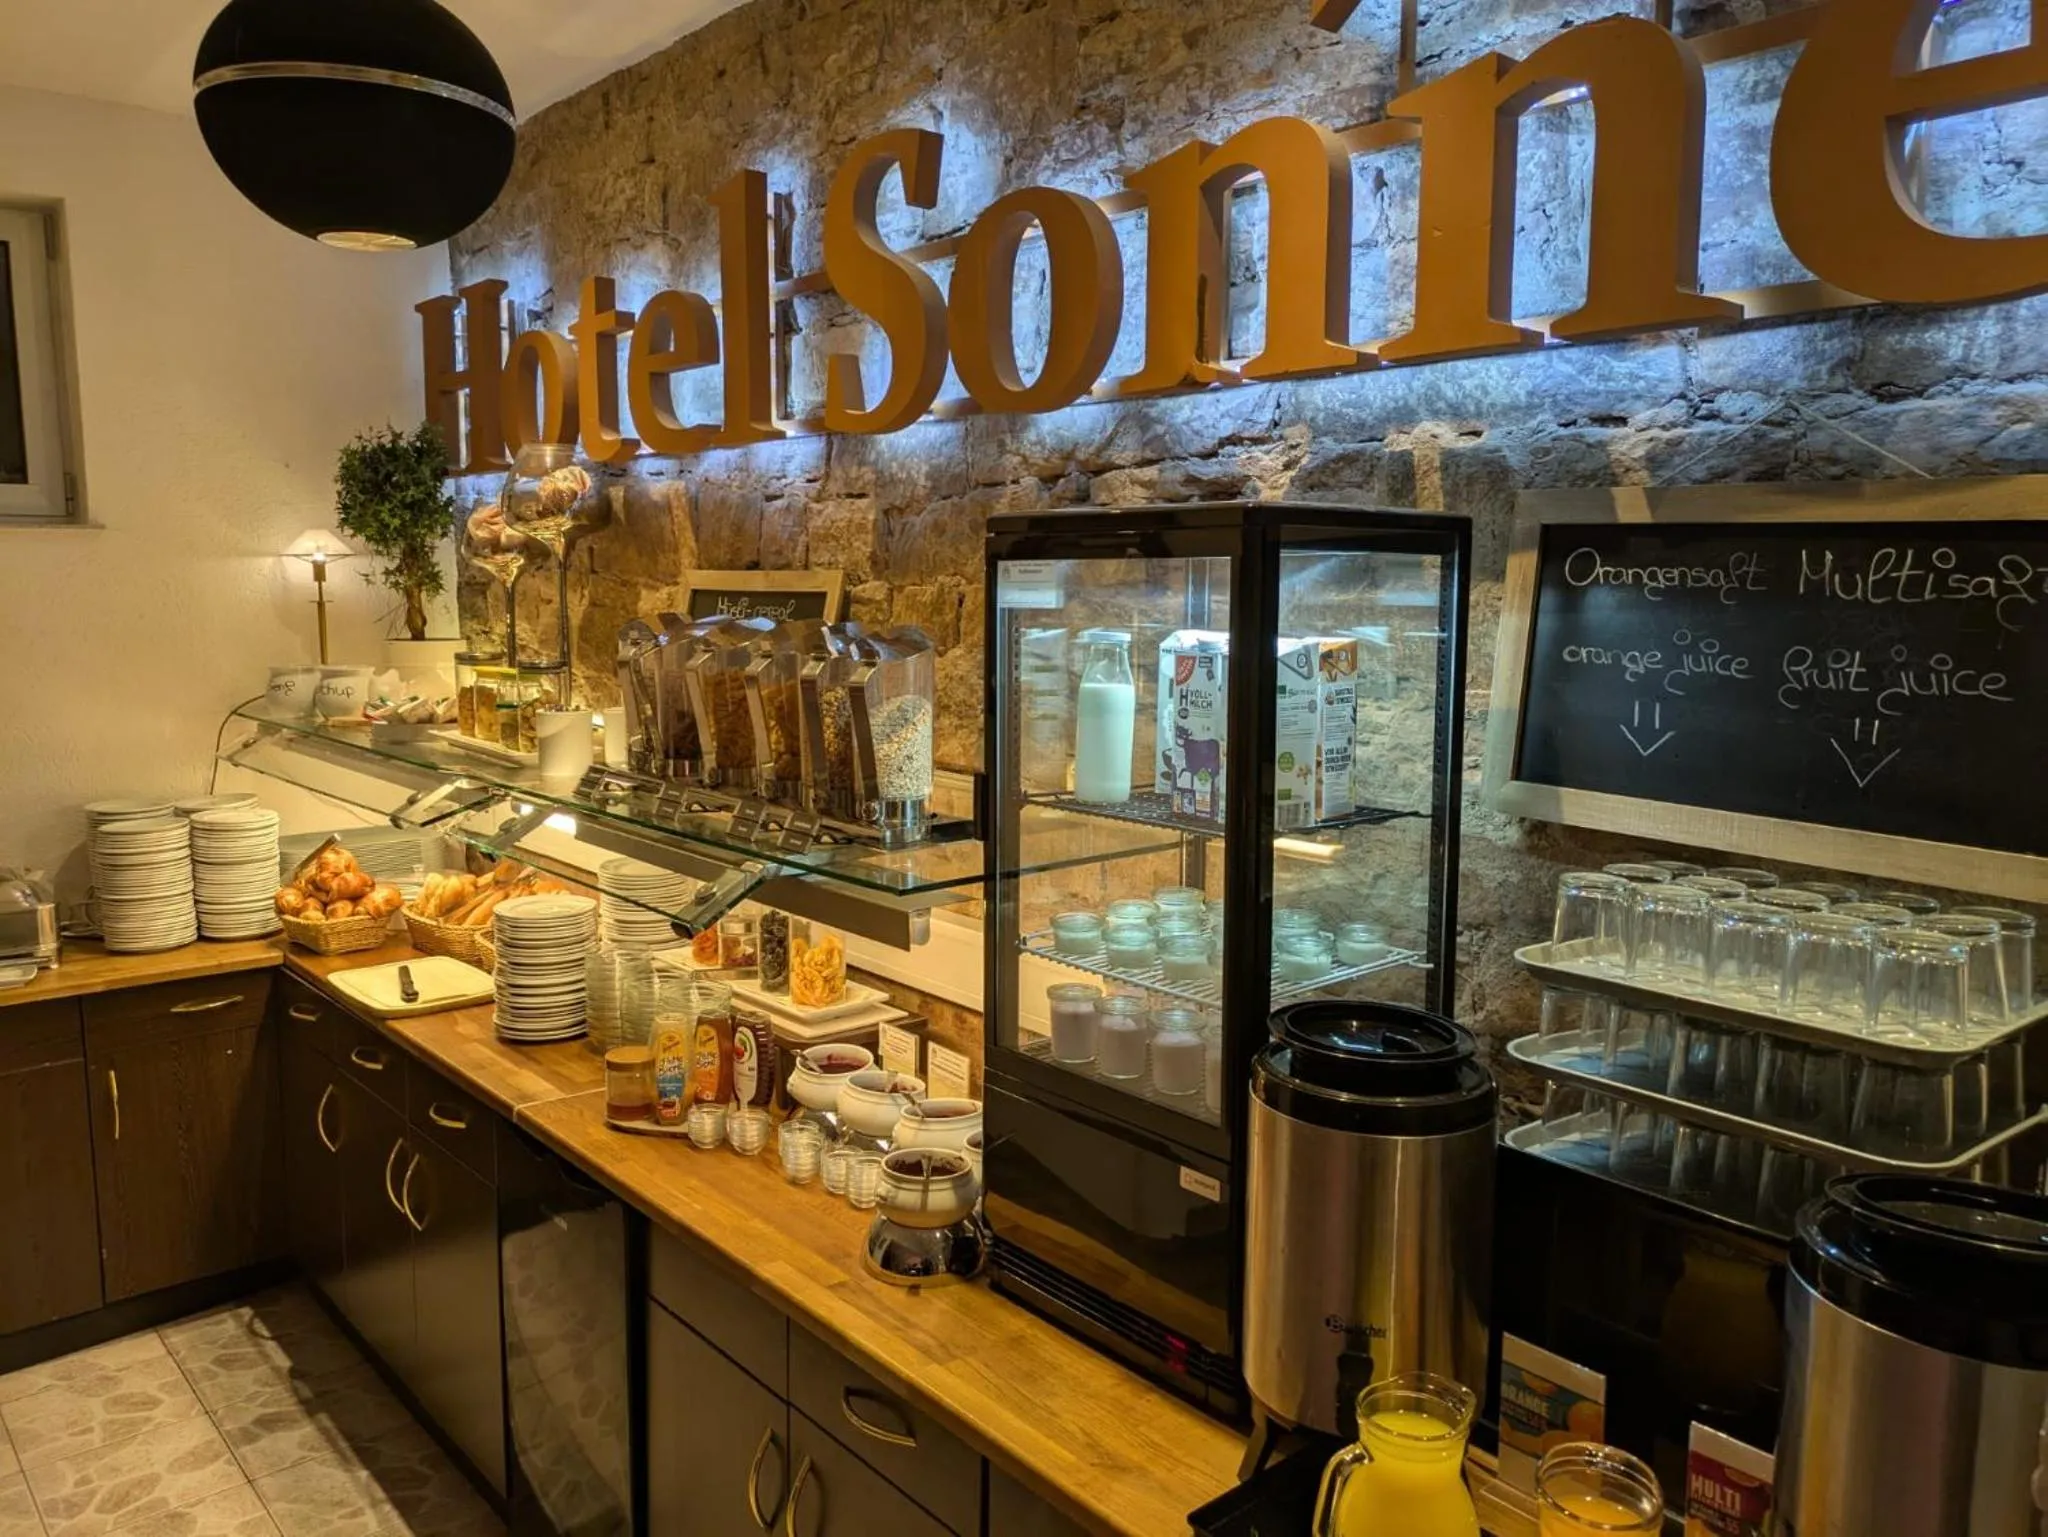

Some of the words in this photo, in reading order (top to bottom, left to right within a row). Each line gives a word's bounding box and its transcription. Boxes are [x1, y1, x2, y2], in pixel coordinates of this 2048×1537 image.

[415, 168, 792, 474] Hotel
[823, 0, 2048, 436] Sonne
[1565, 547, 1768, 604] Orangensaft
[1562, 645, 1662, 682] orange
[1664, 629, 1756, 695] juice
[1778, 646, 1870, 709] fruit
[1877, 645, 2015, 716] juice
[1690, 1472, 1742, 1514] MULTI
